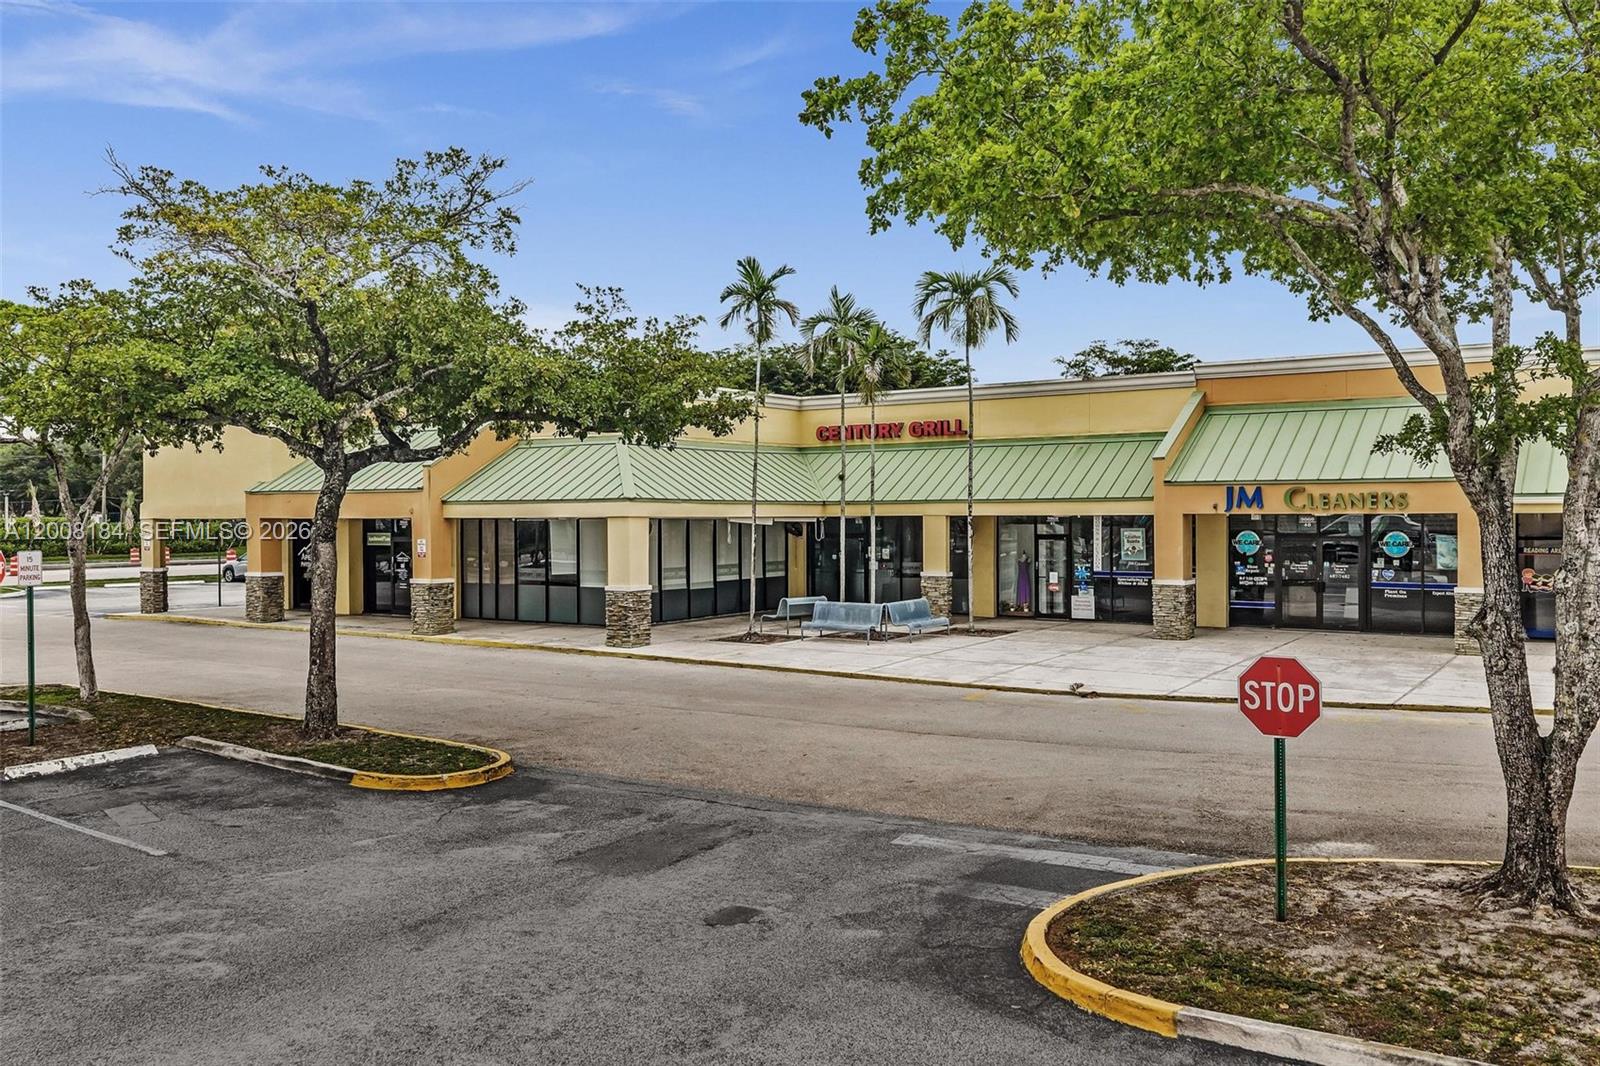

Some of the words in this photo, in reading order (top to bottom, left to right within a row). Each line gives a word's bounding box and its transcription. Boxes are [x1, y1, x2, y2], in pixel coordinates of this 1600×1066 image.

[816, 423, 904, 441] CENTURY
[909, 419, 967, 437] GRILL
[1224, 486, 1264, 512] JM
[1244, 680, 1316, 713] STOP
